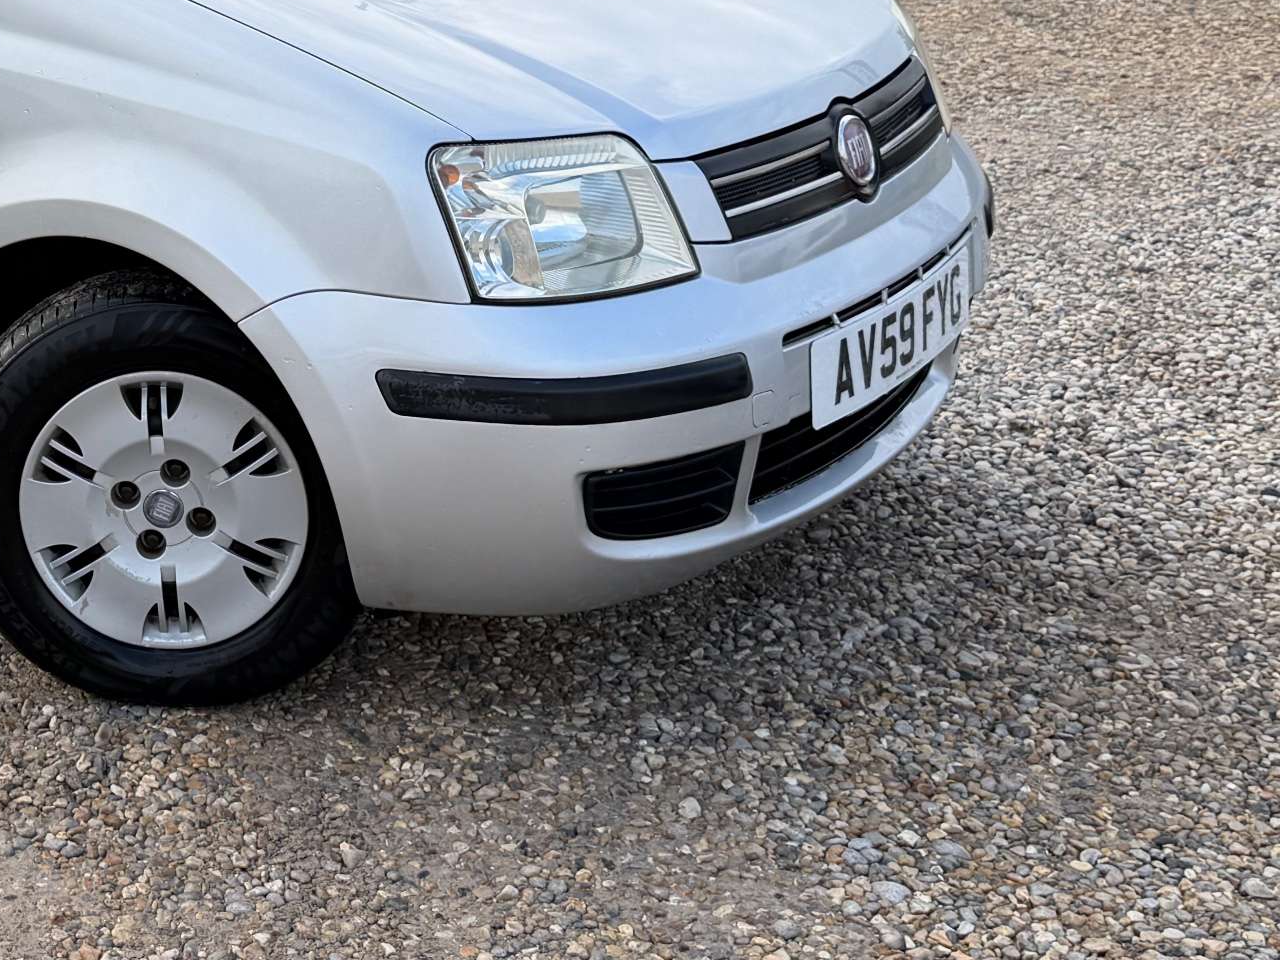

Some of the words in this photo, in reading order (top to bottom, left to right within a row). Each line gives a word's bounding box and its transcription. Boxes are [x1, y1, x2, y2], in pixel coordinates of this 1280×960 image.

[847, 133, 868, 170] FIAT
[835, 301, 915, 406] AV59
[922, 264, 961, 352] FYG
